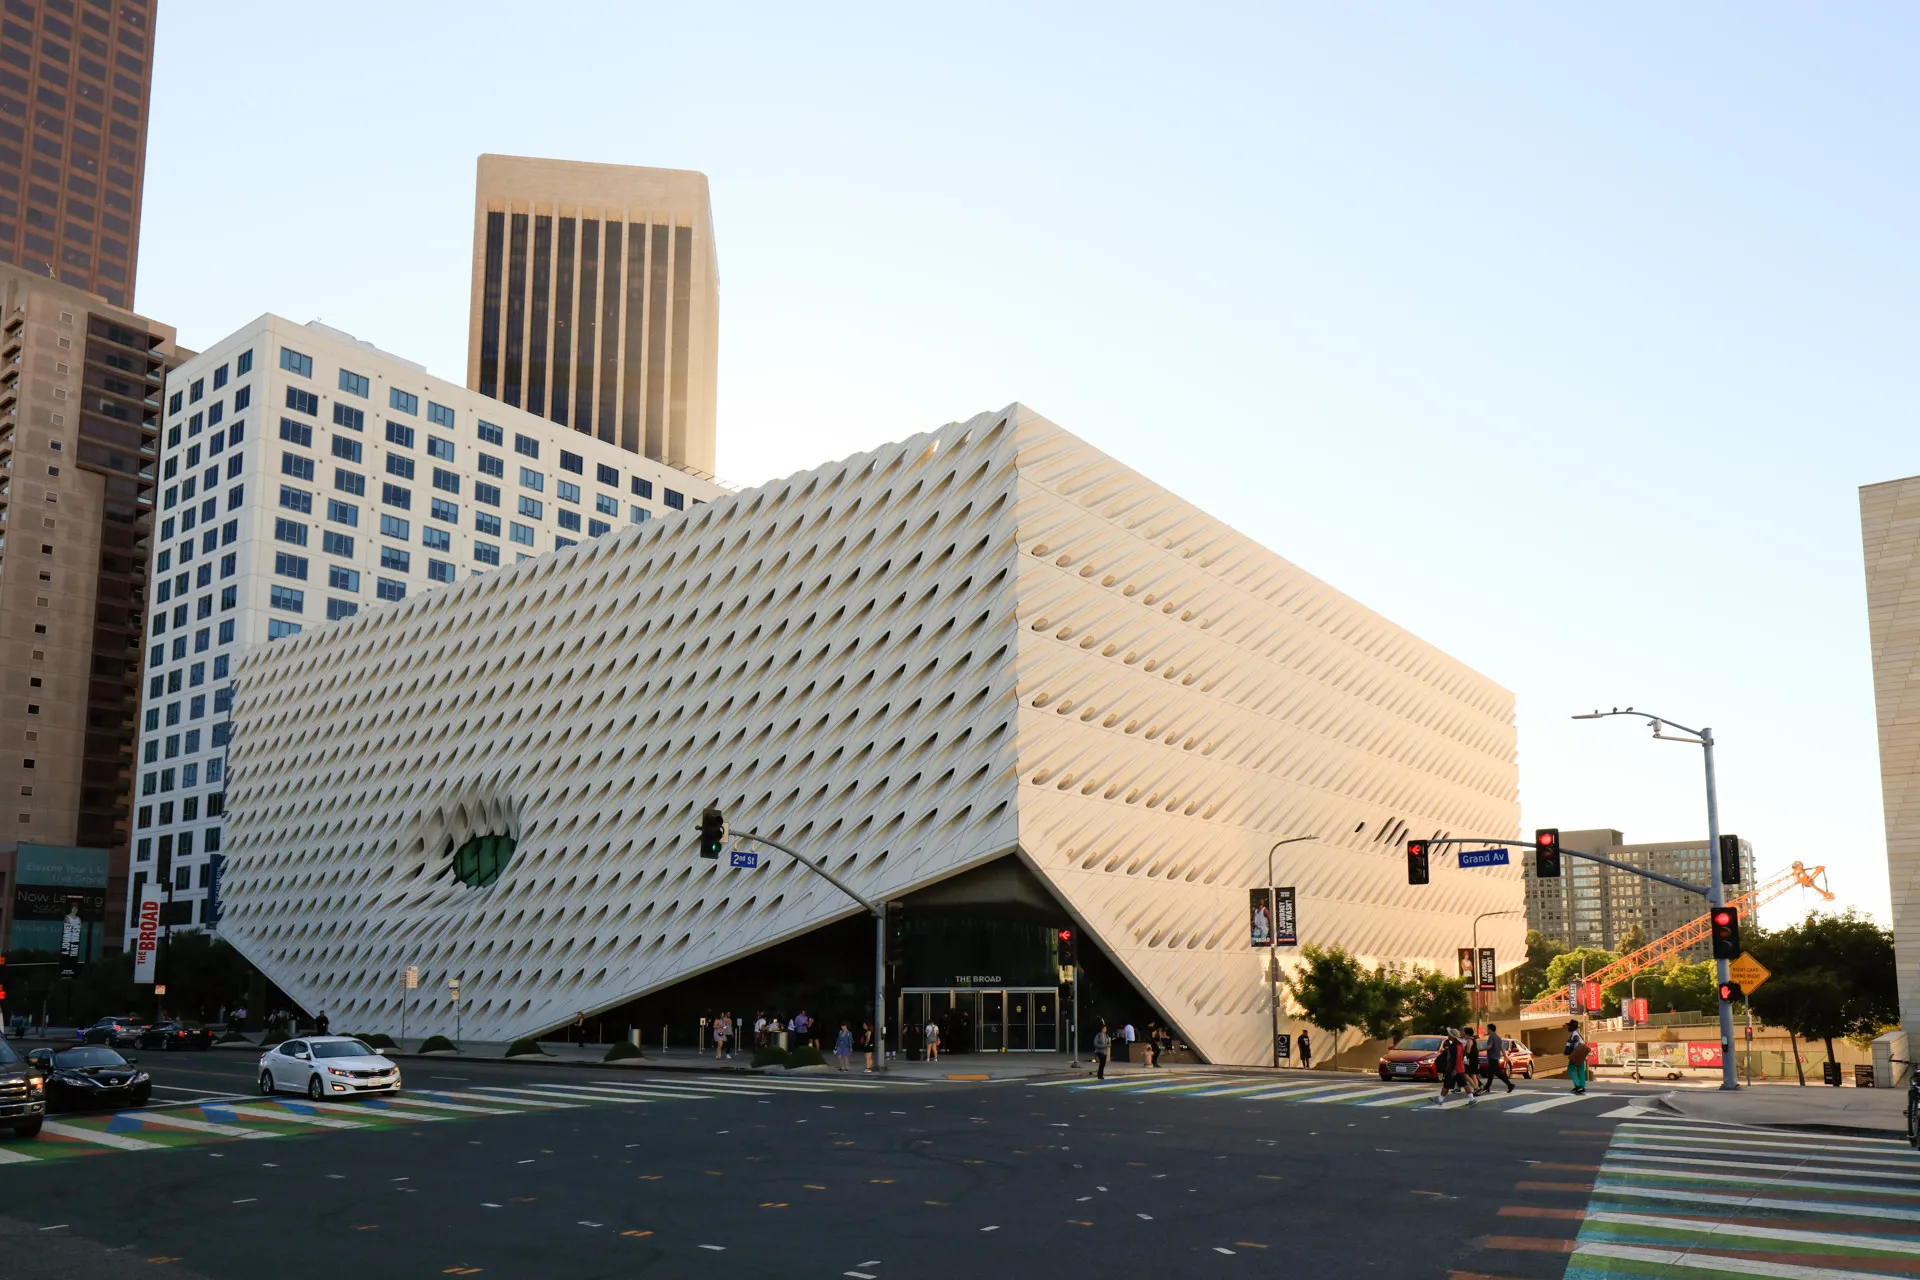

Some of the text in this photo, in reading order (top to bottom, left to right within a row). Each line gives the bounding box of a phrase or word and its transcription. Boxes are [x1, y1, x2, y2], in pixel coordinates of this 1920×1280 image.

[733, 854, 755, 864] 2nd St
[1462, 852, 1504, 864] Grand Av
[18, 890, 102, 908] Now Leing
[137, 902, 158, 965] THE BROAD
[70, 944, 79, 957] THAT
